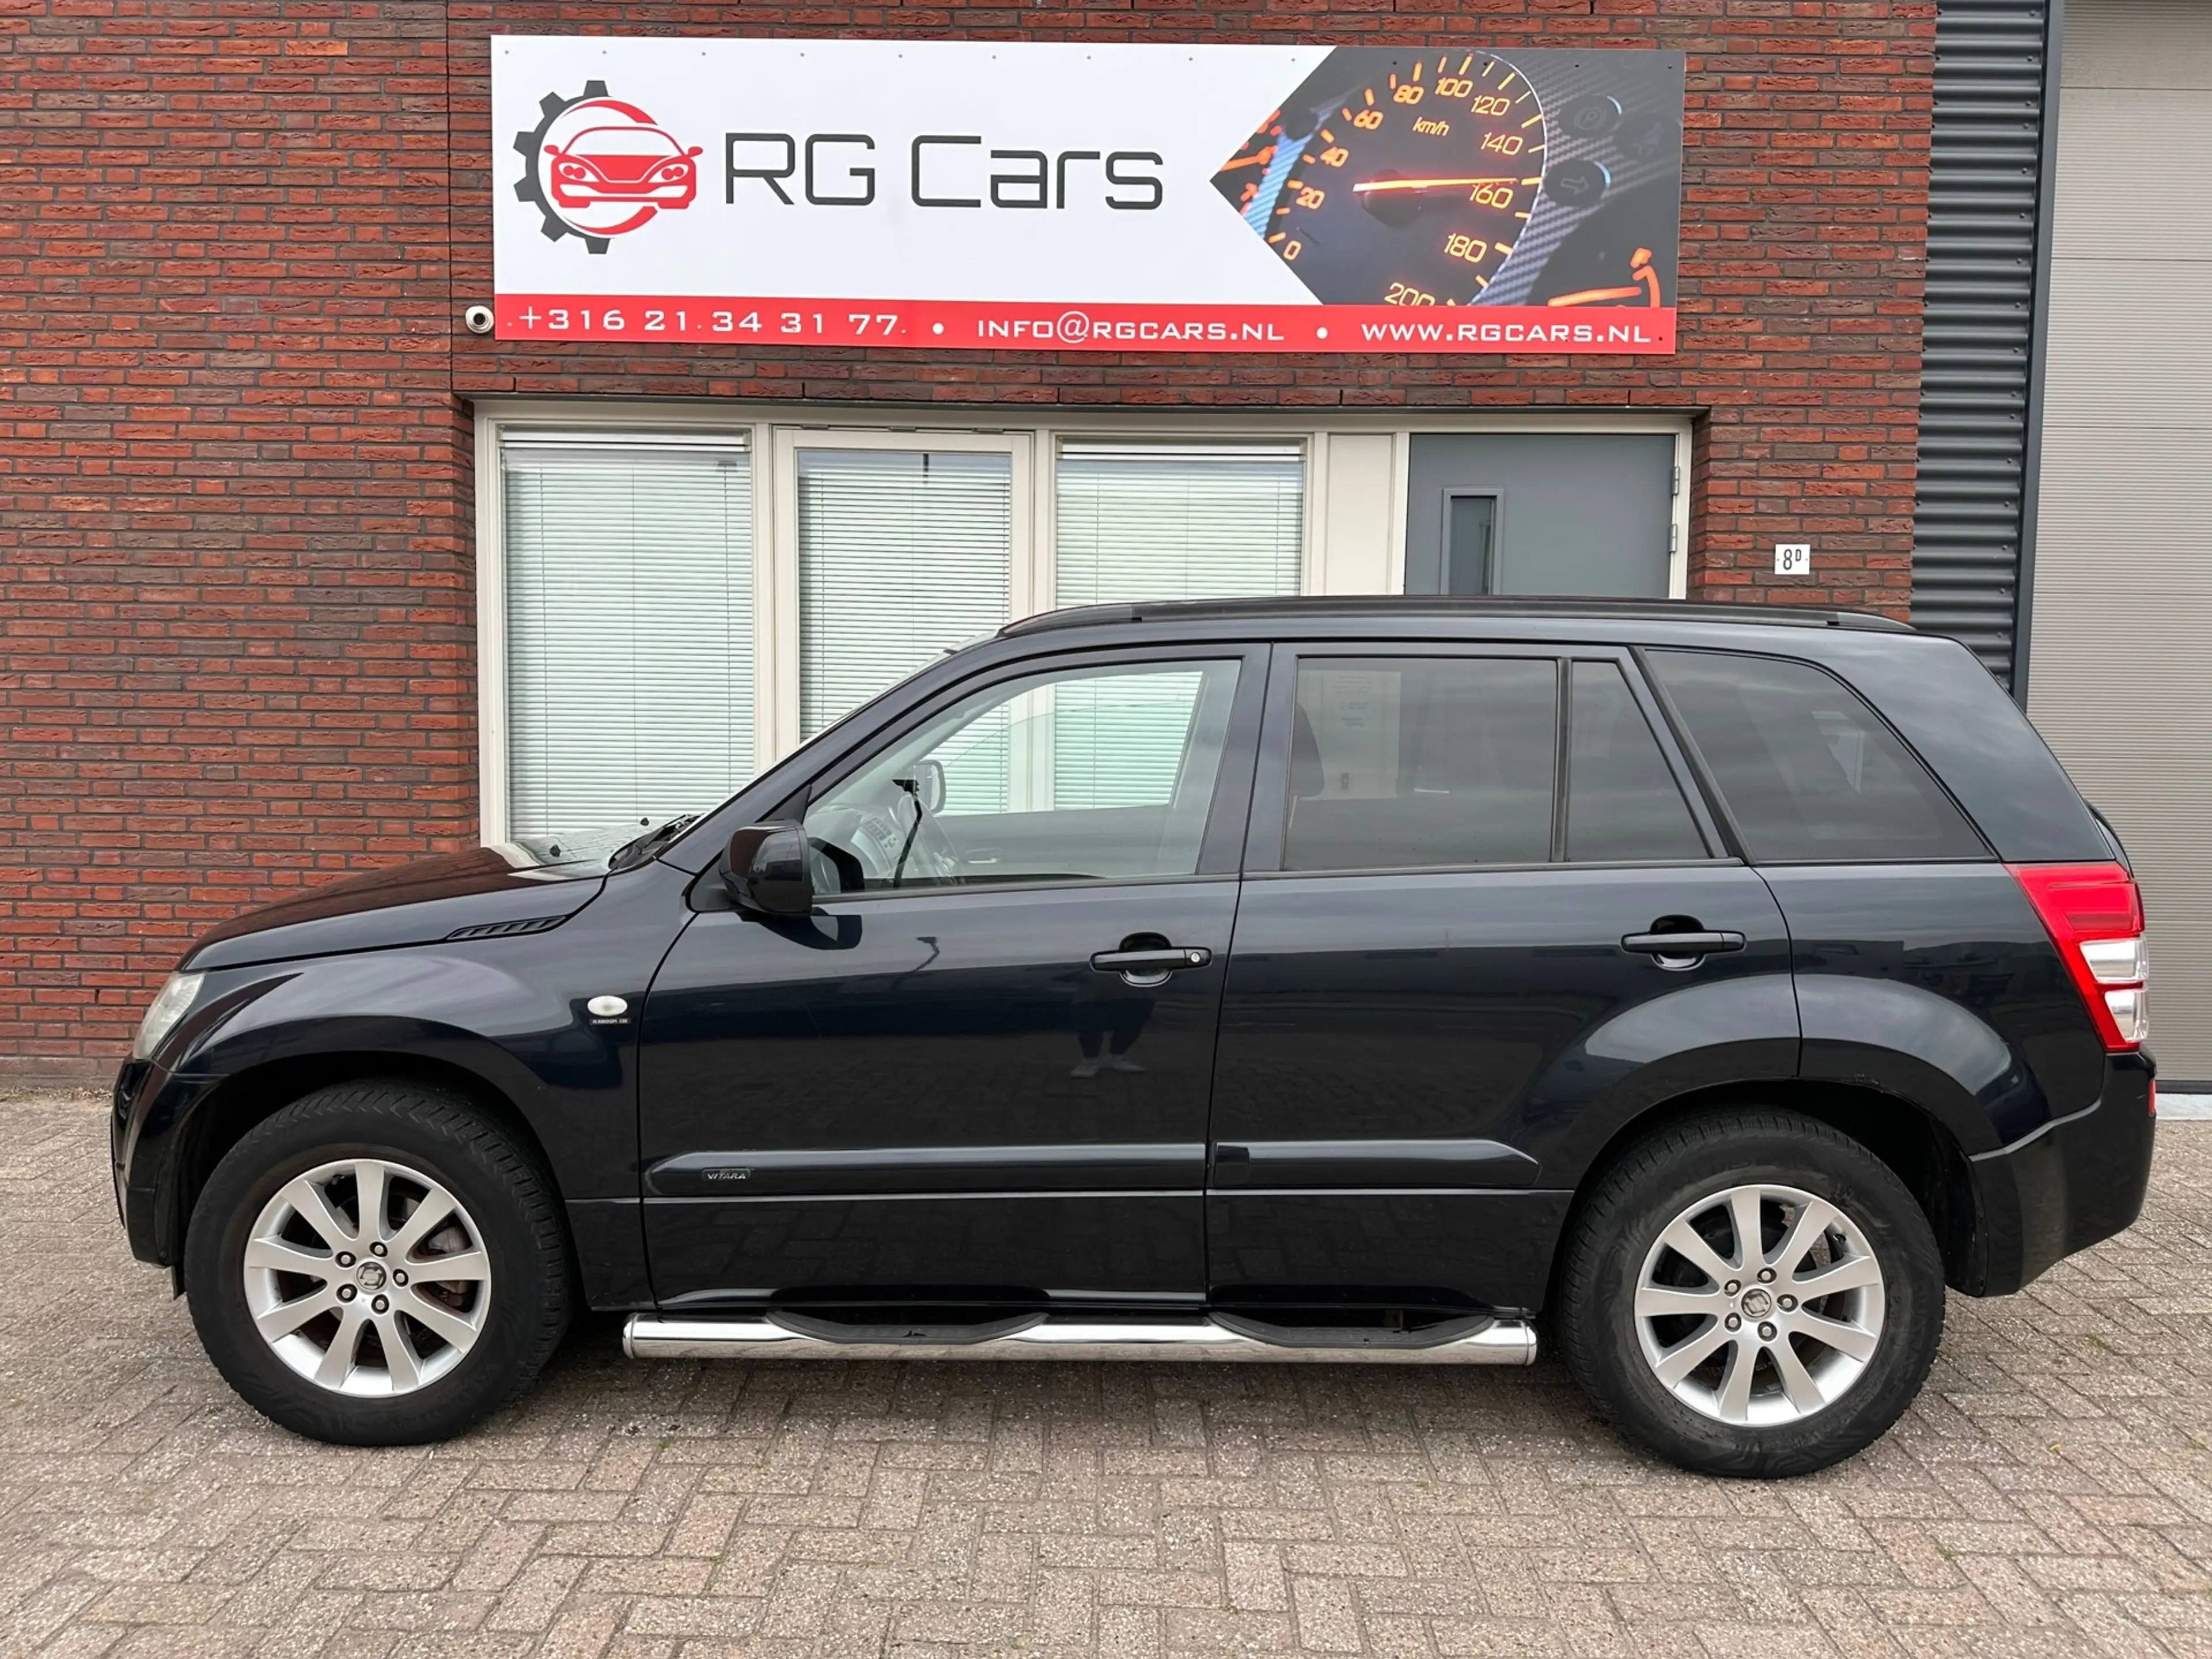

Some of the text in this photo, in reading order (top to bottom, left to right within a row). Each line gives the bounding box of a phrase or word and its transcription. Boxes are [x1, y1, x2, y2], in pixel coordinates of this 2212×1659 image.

[1393, 84, 1425, 104] 80
[1434, 77, 1473, 97] 100
[1471, 95, 1510, 116] 120
[1354, 109, 1384, 130] 60
[1412, 116, 1450, 137] km/h
[1480, 132, 1523, 155] 140
[1320, 146, 1349, 167] 40
[725, 132, 1164, 210] RG Cars
[1296, 187, 1325, 210] 20
[1469, 183, 1514, 209] 160
[1283, 240, 1302, 260] 0
[1444, 233, 1487, 263] 180
[1384, 282, 1435, 306] 200
[518, 306, 625, 330] +316
[644, 310, 686, 331] 21
[711, 311, 763, 332] 34
[780, 313, 823, 334] 31
[978, 310, 1285, 343] INFO@RGCARS.NL
[1361, 324, 1652, 343] WWW.RGCARS.NL
